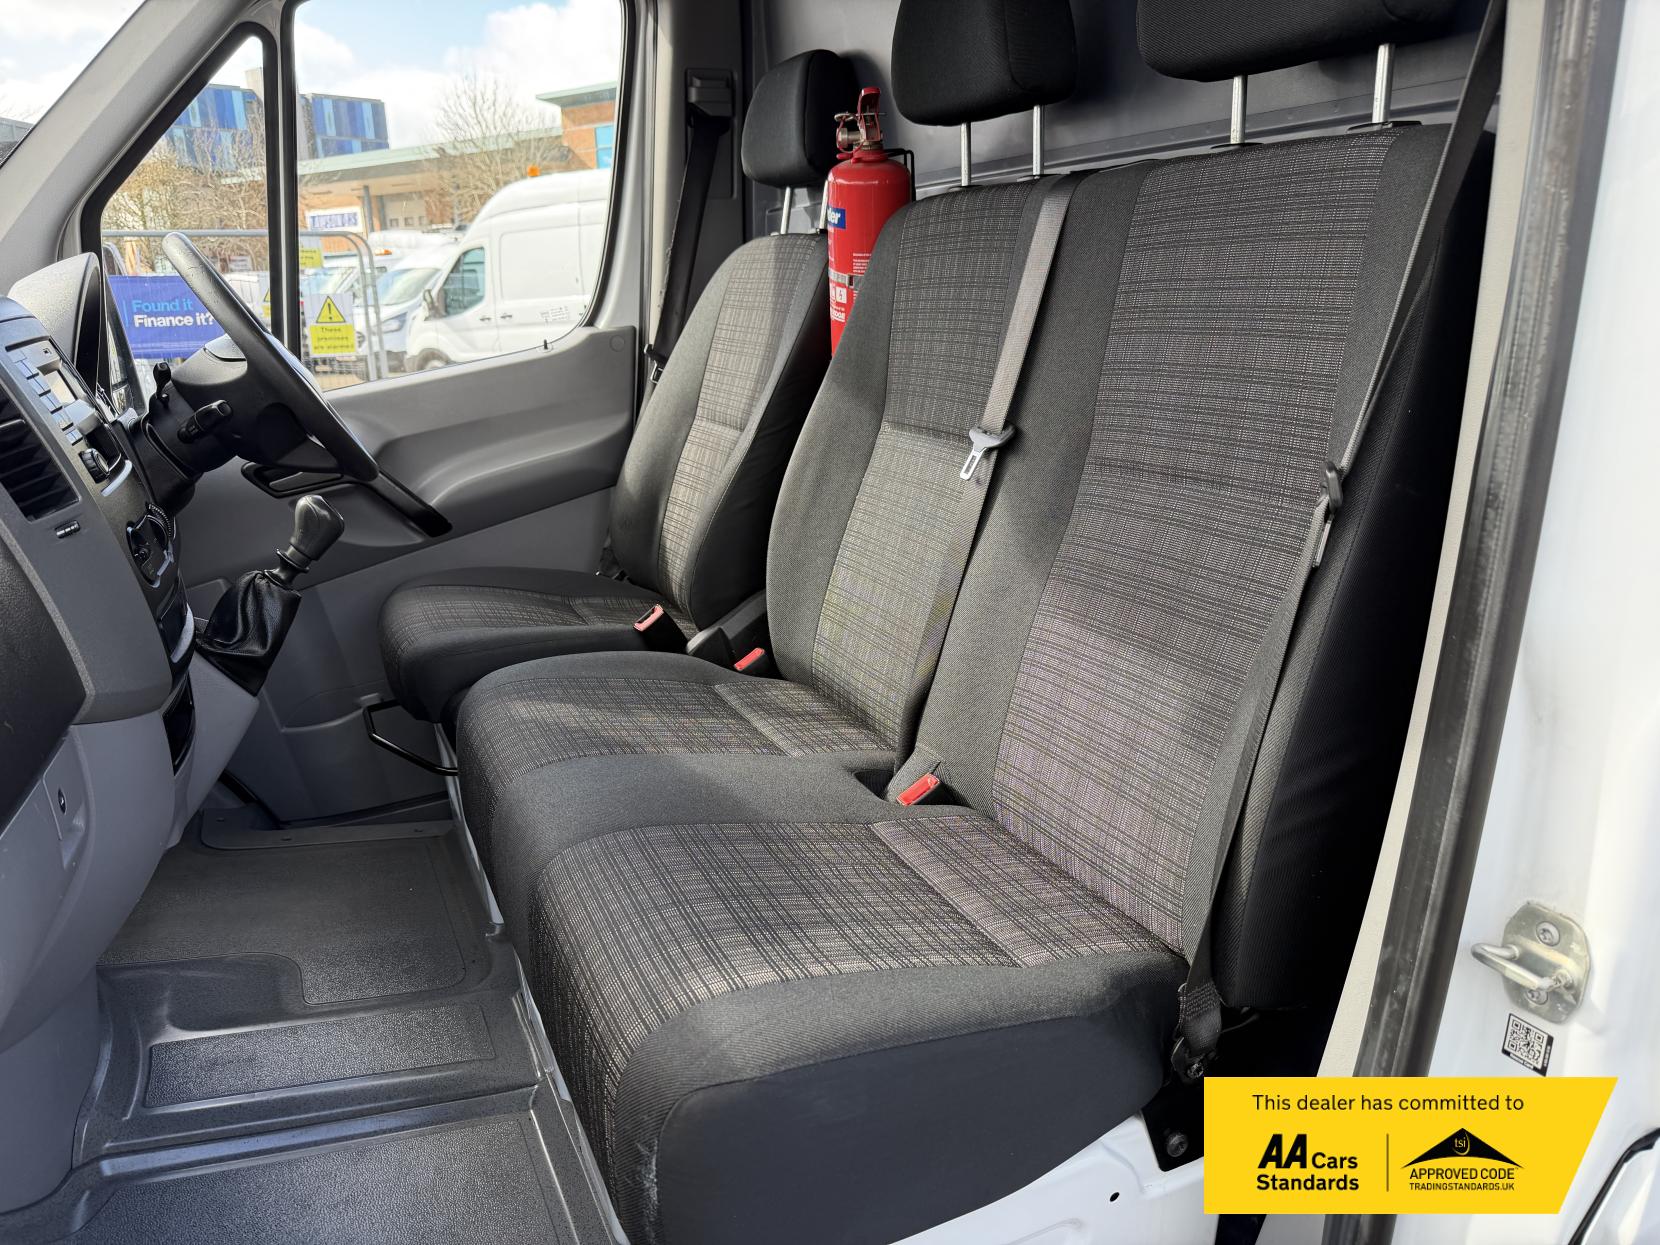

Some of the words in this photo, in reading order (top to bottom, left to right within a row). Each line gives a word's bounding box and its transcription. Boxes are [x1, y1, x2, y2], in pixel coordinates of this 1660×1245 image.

[132, 299, 180, 312] Found
[183, 299, 193, 311] it
[134, 314, 193, 327] Finance
[195, 312, 214, 325] it?
